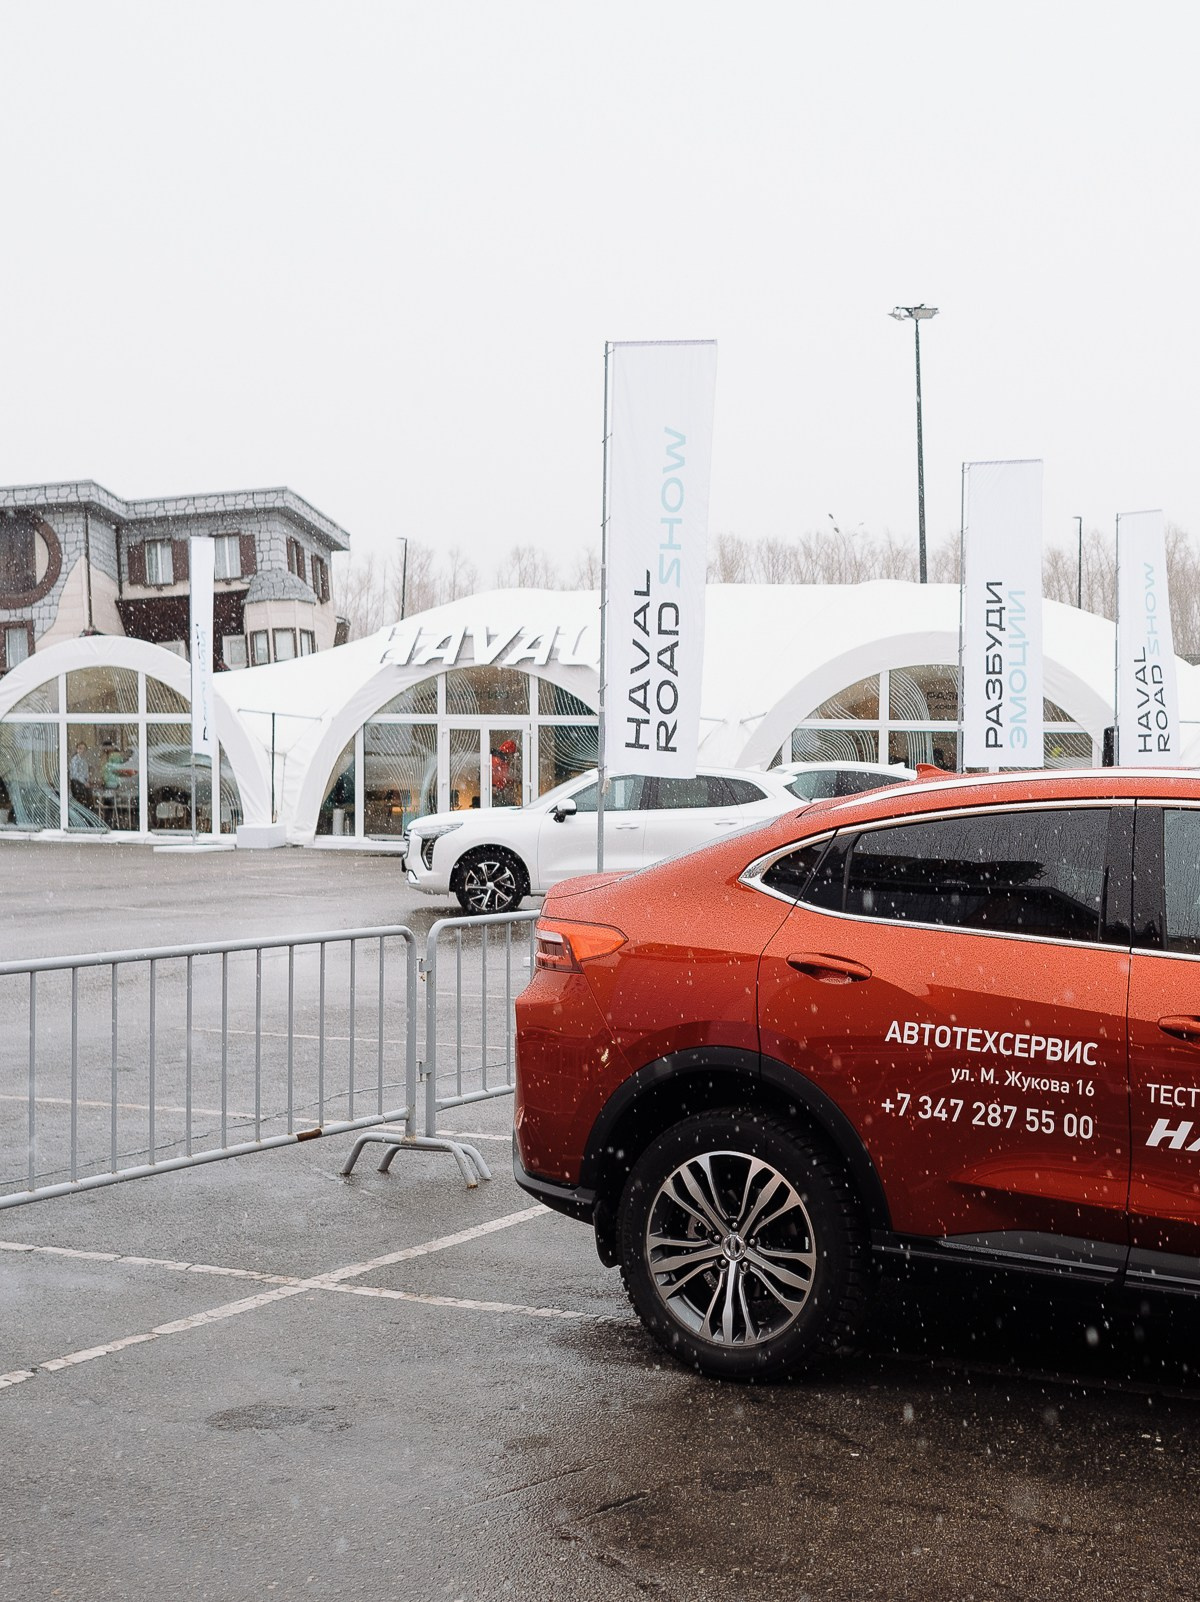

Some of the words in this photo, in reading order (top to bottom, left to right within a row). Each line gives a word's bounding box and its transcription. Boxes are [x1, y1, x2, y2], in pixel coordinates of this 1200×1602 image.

[658, 426, 687, 588] SHOW
[379, 625, 601, 666] HAVAL
[625, 569, 651, 750] HAVAL
[1143, 561, 1161, 657] SHOW
[656, 602, 679, 752] ROAD
[985, 581, 1005, 748] РАЗБУДИ
[1007, 589, 1030, 750] ЭМОЦИИ
[1133, 646, 1153, 753] HAVAL
[1152, 665, 1171, 752] ROAD
[884, 1020, 1099, 1066] АВТОТЕХСЕРВИС
[951, 1066, 974, 1084] ул.
[980, 1067, 1000, 1085] М.
[1003, 1069, 1070, 1094] Жукова
[1075, 1079, 1095, 1097] 16
[881, 1093, 911, 1117] +7
[918, 1095, 964, 1123] 347
[971, 1101, 1018, 1129] 287
[1025, 1107, 1055, 1134] 55
[1063, 1113, 1093, 1140] 00
